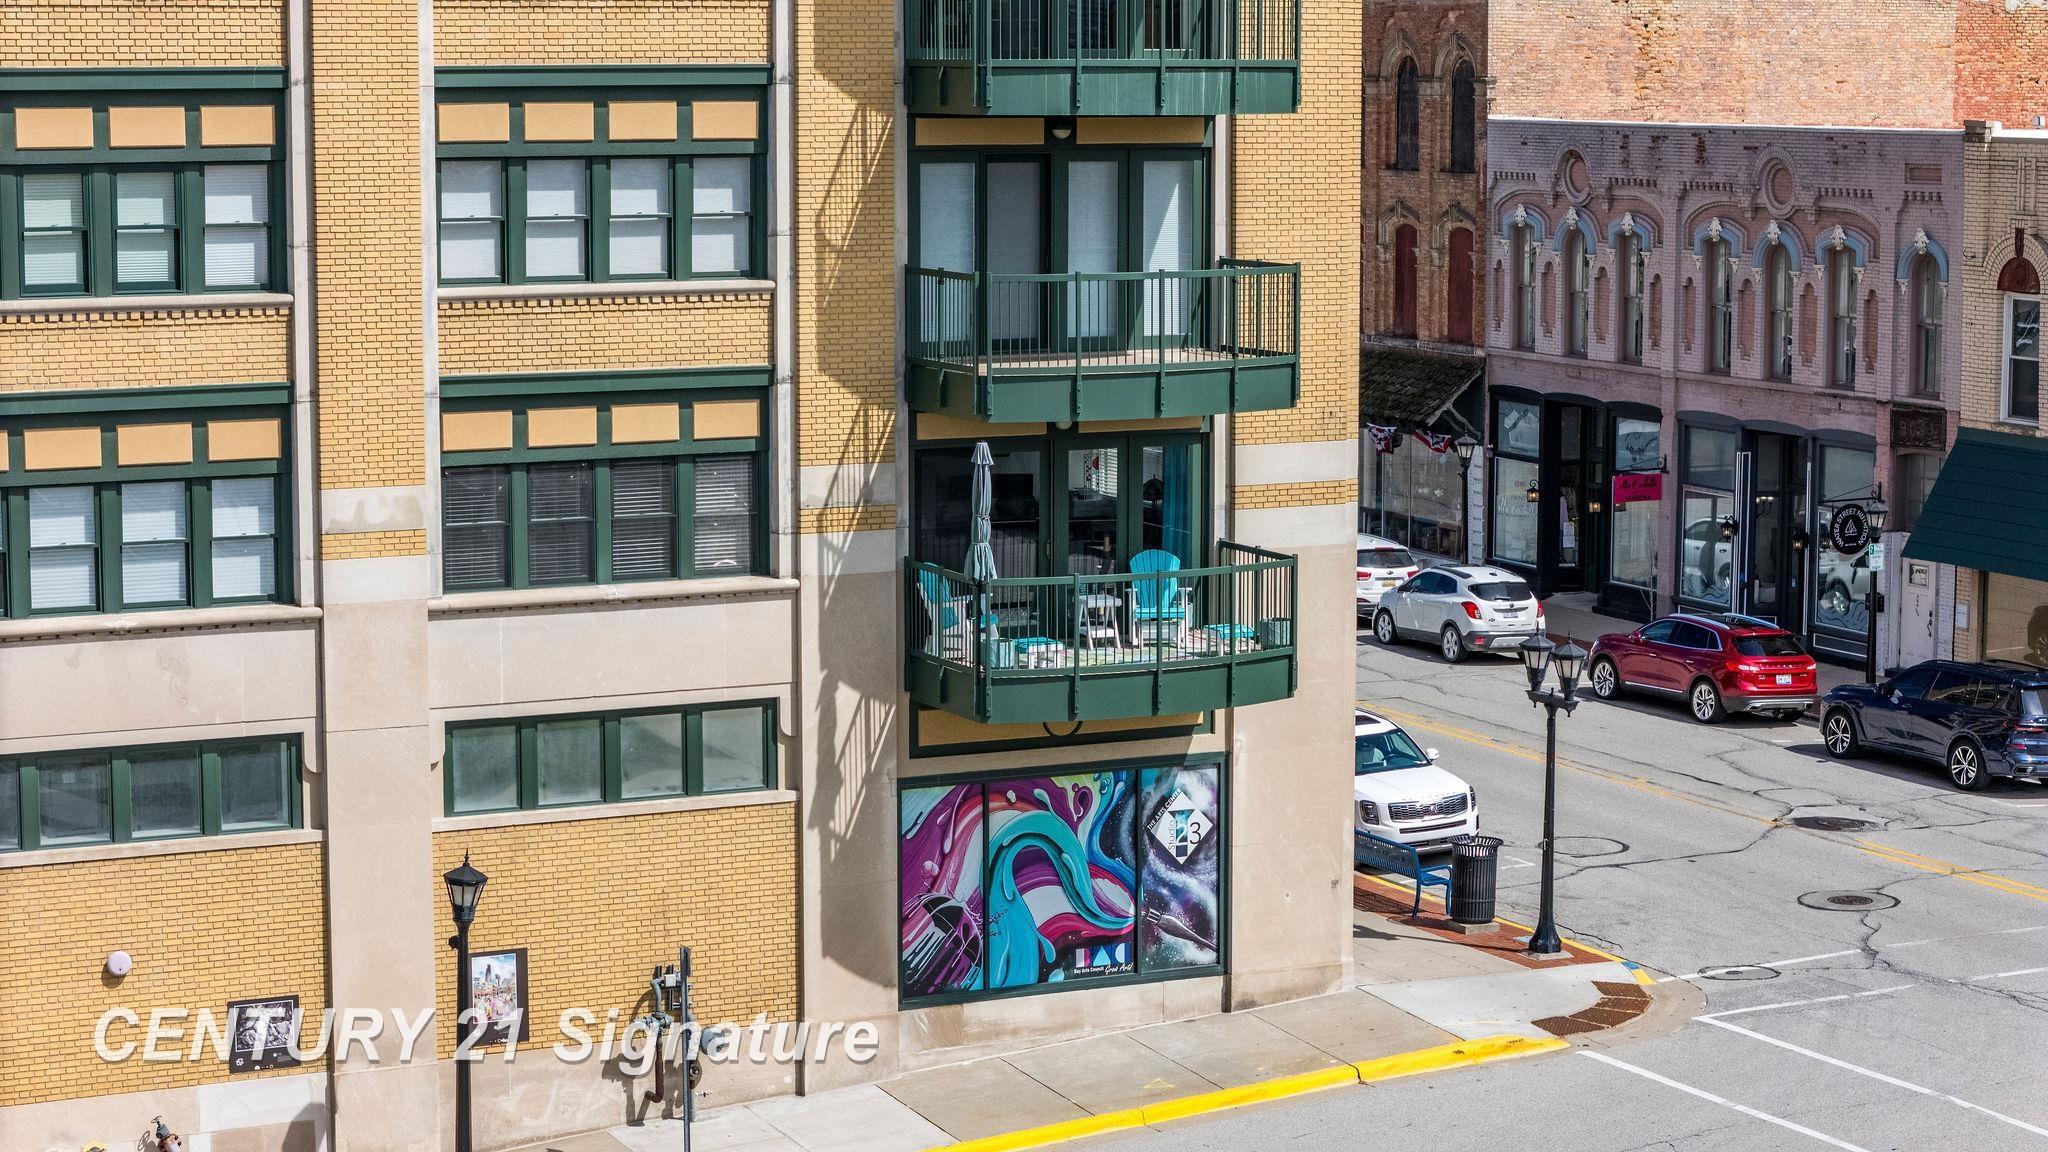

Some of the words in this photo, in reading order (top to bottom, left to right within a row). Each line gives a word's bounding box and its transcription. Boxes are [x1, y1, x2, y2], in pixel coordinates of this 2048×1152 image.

[1837, 508, 1857, 523] STREET
[1856, 511, 1869, 545] NUTRITION
[1834, 523, 1844, 547] WATER
[1147, 820, 1157, 830] THE
[1156, 806, 1167, 820] ARTS
[1165, 787, 1183, 808] CENTER
[1168, 819, 1176, 850] Studio
